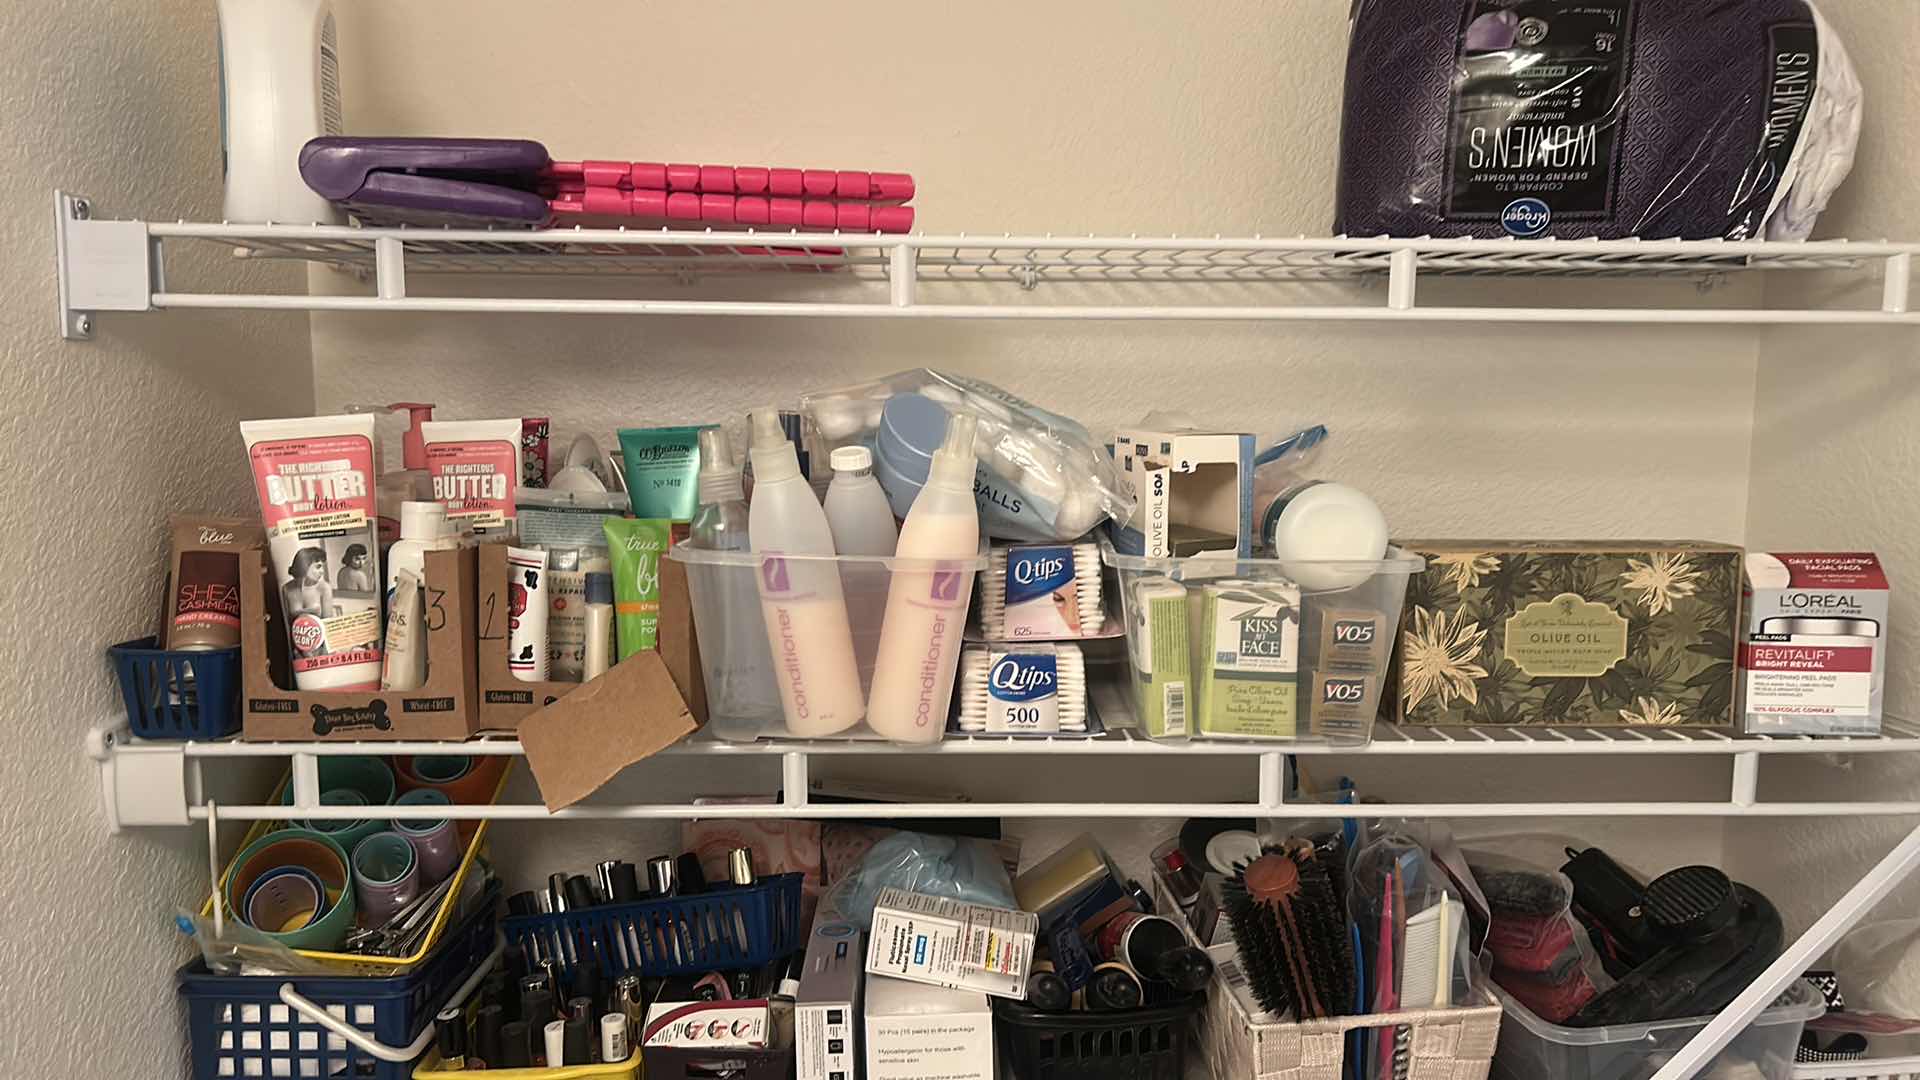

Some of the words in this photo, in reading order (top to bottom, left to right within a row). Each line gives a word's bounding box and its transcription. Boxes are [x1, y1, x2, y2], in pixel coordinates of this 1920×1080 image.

[1595, 39, 1613, 51] 16
[1469, 125, 1596, 168] WOMEN'S
[1520, 172, 1541, 181] FOR
[1495, 182, 1509, 191] TO
[1513, 182, 1563, 190] COMPARE
[1503, 202, 1547, 228] Kroger
[442, 465, 454, 473] THE
[456, 464, 495, 473] RIGHTEOUS
[266, 470, 366, 506] BUTTER
[433, 474, 506, 499] BUTTER
[314, 494, 347, 511] lotion
[1153, 500, 1162, 519] OIL
[200, 529, 233, 544] blue
[624, 534, 660, 551] true
[1152, 524, 1162, 555] OLIVE
[181, 584, 238, 601] SHEA
[1780, 593, 1862, 608] L'ORÉAL
[427, 587, 447, 631] 3
[1014, 627, 1032, 637] 625
[1245, 619, 1278, 633] KISS
[1335, 626, 1373, 641] VO5
[1530, 633, 1571, 643] OLIVE
[1576, 633, 1601, 643] OIL
[1241, 641, 1280, 655] FACE
[1755, 649, 1832, 660] REVITALIFT
[777, 606, 809, 719] conditioner
[915, 613, 947, 728] conditioner
[1326, 684, 1363, 700] VO5
[1006, 708, 1039, 723] 500
[889, 925, 899, 965] Fluticasone
